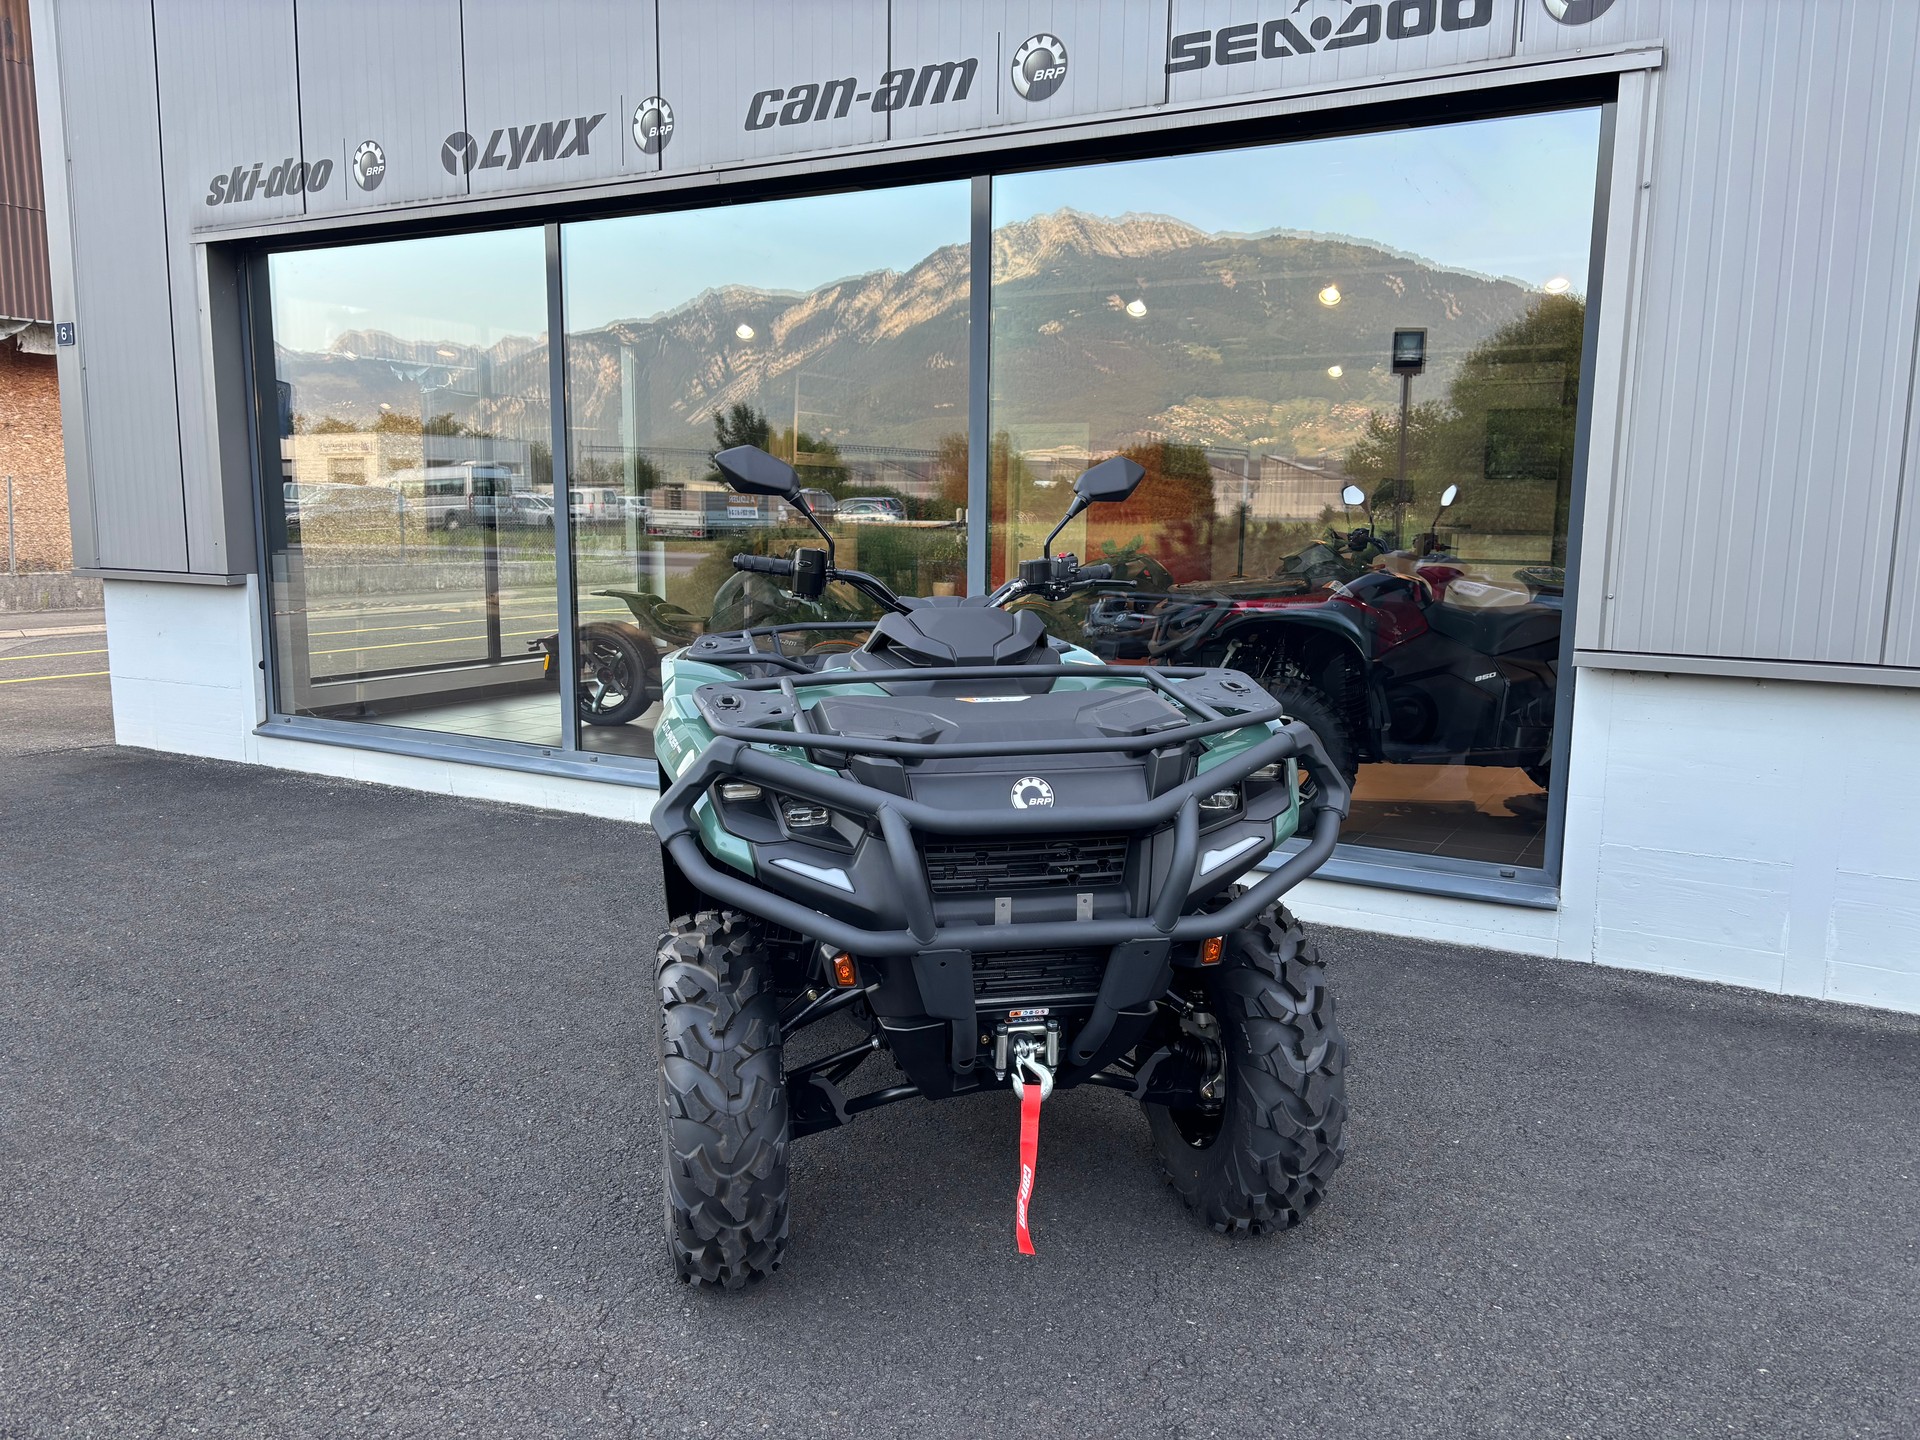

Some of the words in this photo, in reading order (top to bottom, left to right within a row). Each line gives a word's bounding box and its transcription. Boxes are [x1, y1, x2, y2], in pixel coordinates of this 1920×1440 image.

[1033, 66, 1066, 82] BRP
[744, 57, 978, 131] can-am
[649, 124, 673, 137] BRP
[478, 113, 607, 170] LYNX
[366, 166, 385, 176] BRP
[206, 158, 333, 207] ski-doo
[61, 326, 67, 340] 6
[1475, 672, 1496, 682] 850
[1019, 1163, 1031, 1229] can-am
